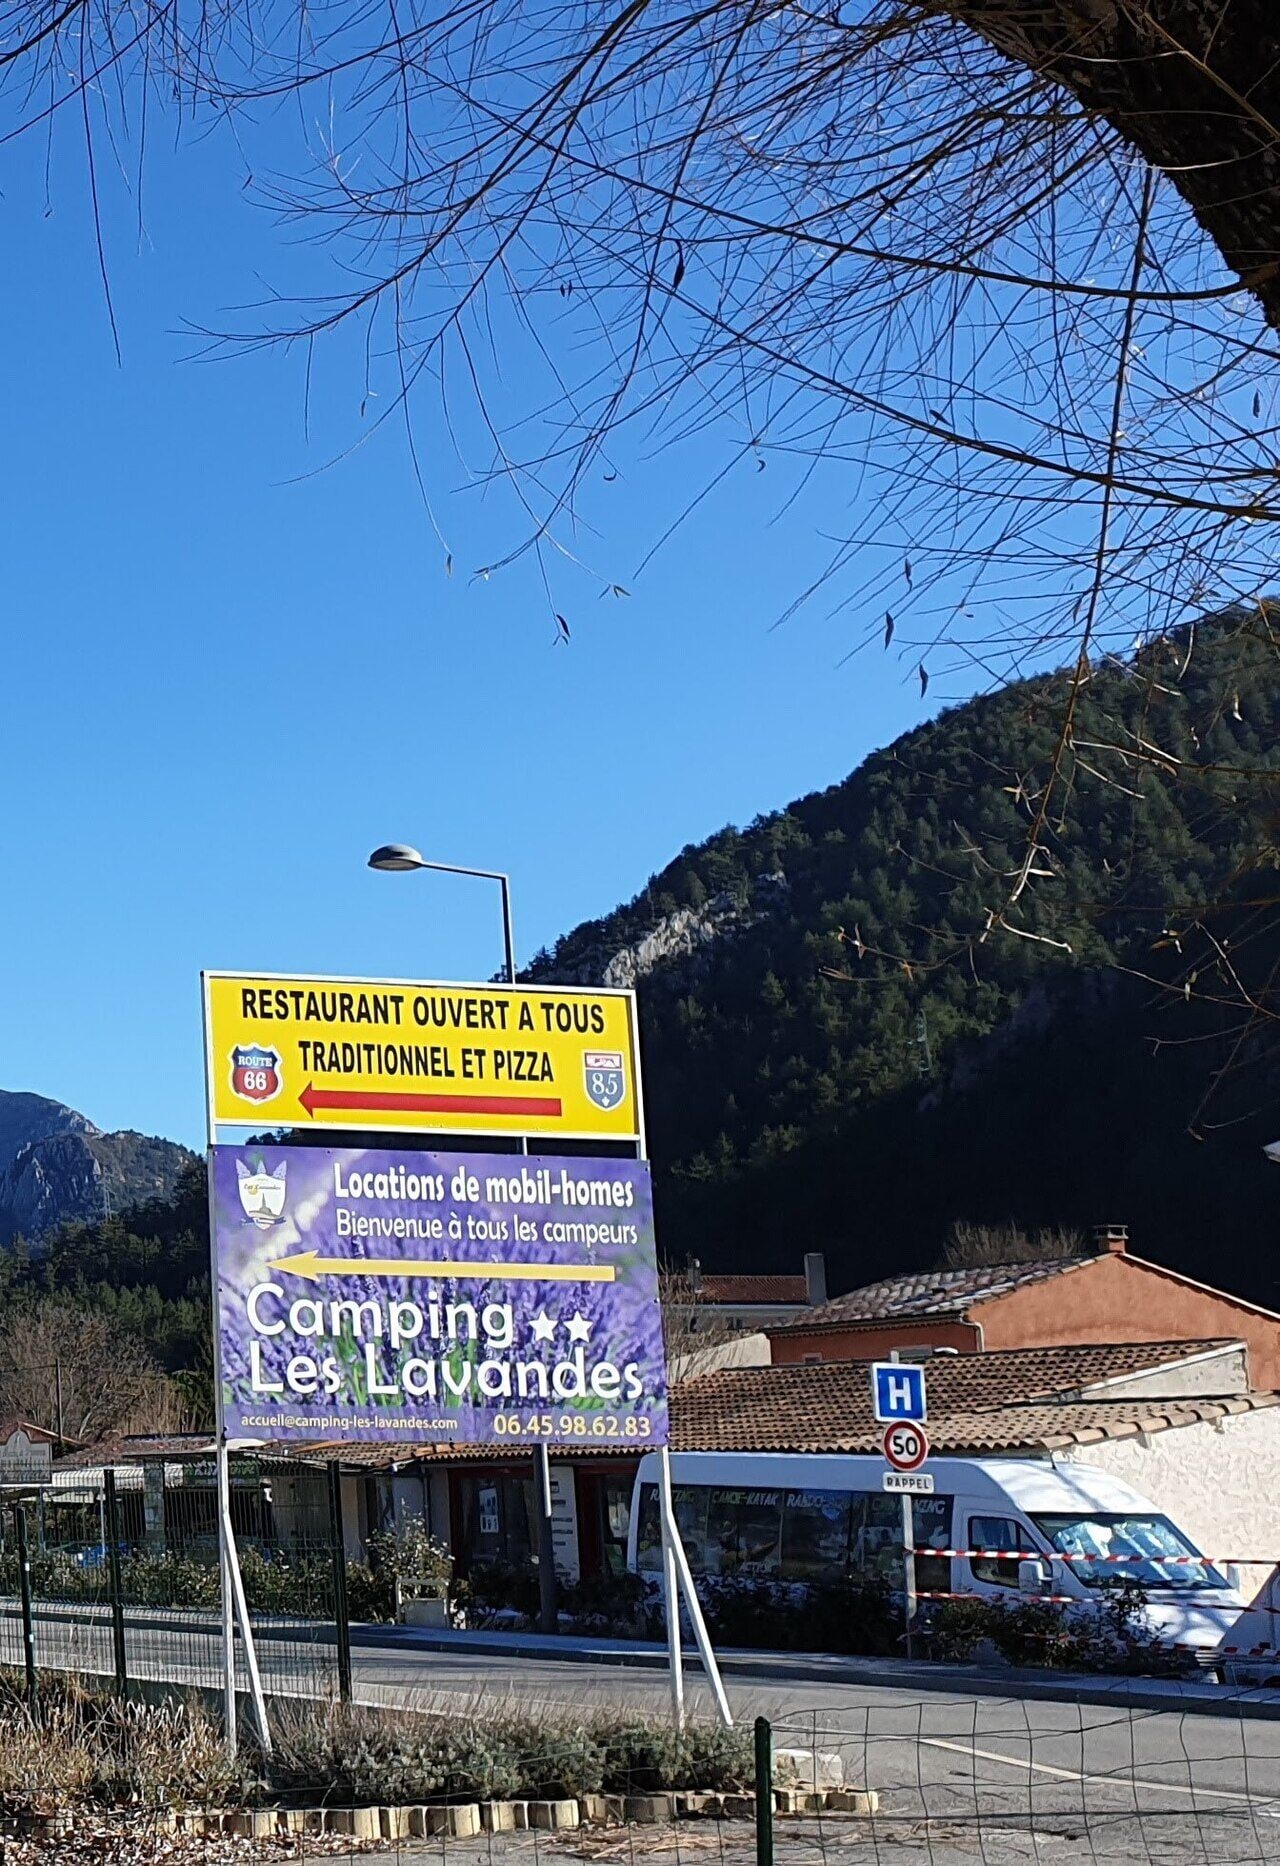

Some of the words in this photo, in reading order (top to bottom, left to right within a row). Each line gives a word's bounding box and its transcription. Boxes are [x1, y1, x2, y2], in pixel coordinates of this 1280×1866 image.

[242, 988, 404, 1025] RESTAURANT
[413, 996, 509, 1029] OUVERT
[519, 1001, 534, 1031] A
[540, 1002, 604, 1034] TOUS
[237, 1055, 273, 1067] ROUTE
[298, 1040, 455, 1078] TRADITIONNEL
[461, 1048, 486, 1079] ET
[493, 1050, 554, 1082] PIZZA
[244, 1070, 267, 1091] 66
[592, 1072, 618, 1095] 85
[334, 1162, 445, 1201] Locations
[451, 1165, 480, 1202] de
[486, 1168, 634, 1207] mobil-homes
[336, 1208, 443, 1239] Bienvenue
[448, 1211, 462, 1240] à
[467, 1214, 509, 1241] tous
[513, 1214, 538, 1241] les
[543, 1221, 638, 1248] campeurs
[247, 1282, 514, 1349] Camping
[249, 1340, 340, 1394] Les
[365, 1343, 643, 1399] Lavandes
[888, 1376, 912, 1411] H
[241, 1413, 459, 1430] accueil@camping-les-lavandes.com
[493, 1414, 652, 1437] 06.45.98.62.83
[893, 1435, 918, 1456] 50
[886, 1477, 930, 1489] RAPPEL
